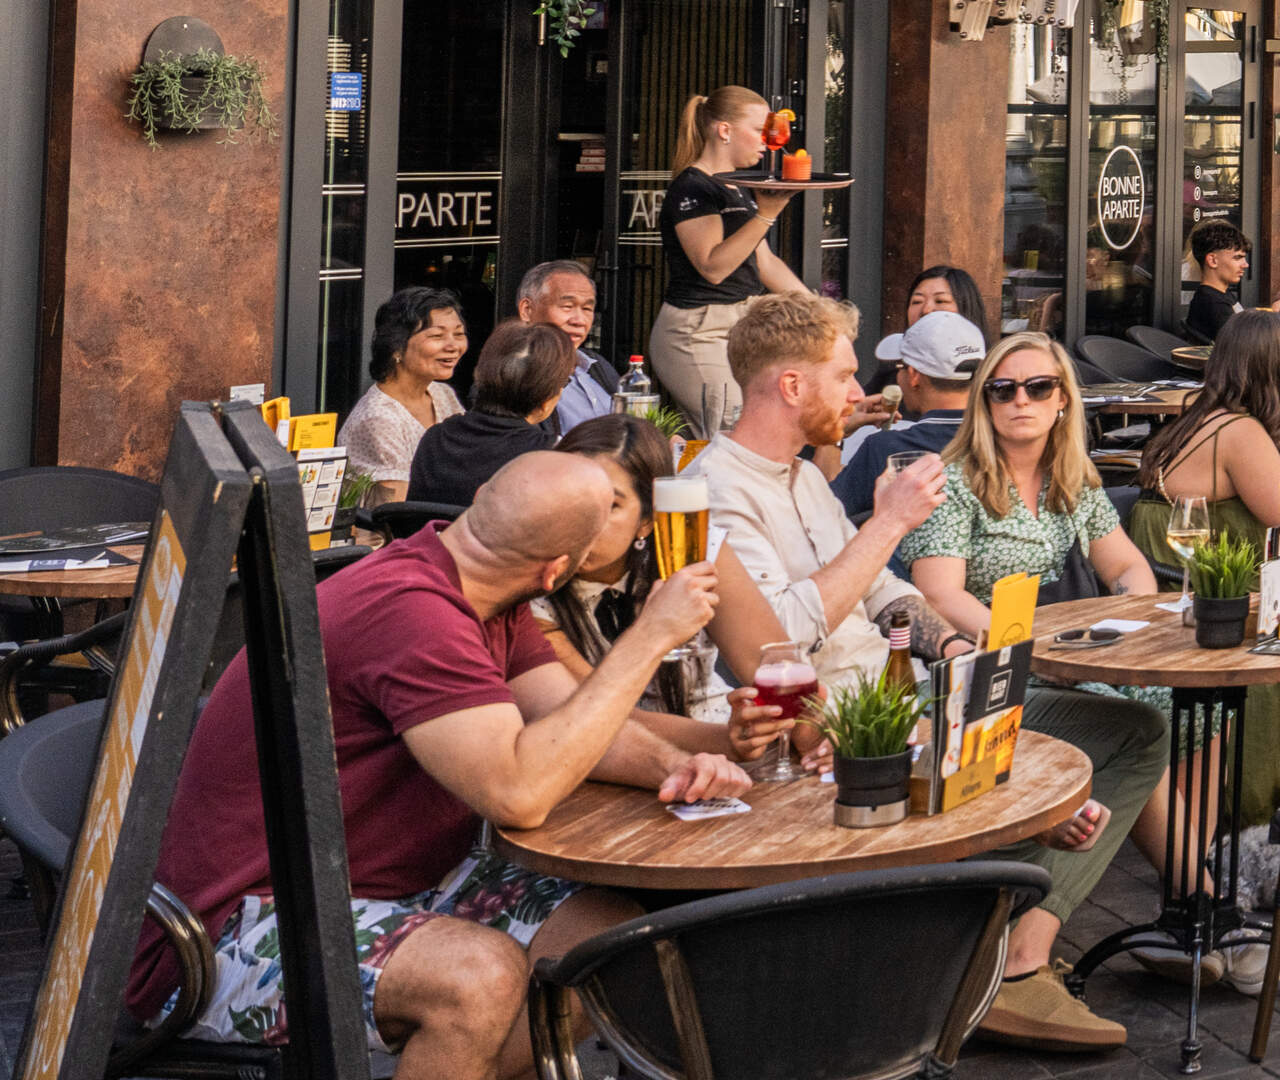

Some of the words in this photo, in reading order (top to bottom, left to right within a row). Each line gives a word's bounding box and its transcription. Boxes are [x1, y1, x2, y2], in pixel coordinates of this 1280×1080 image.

[1103, 176, 1141, 197] BONNE
[395, 191, 492, 228] PARTE
[1102, 199, 1140, 220] APARTE
